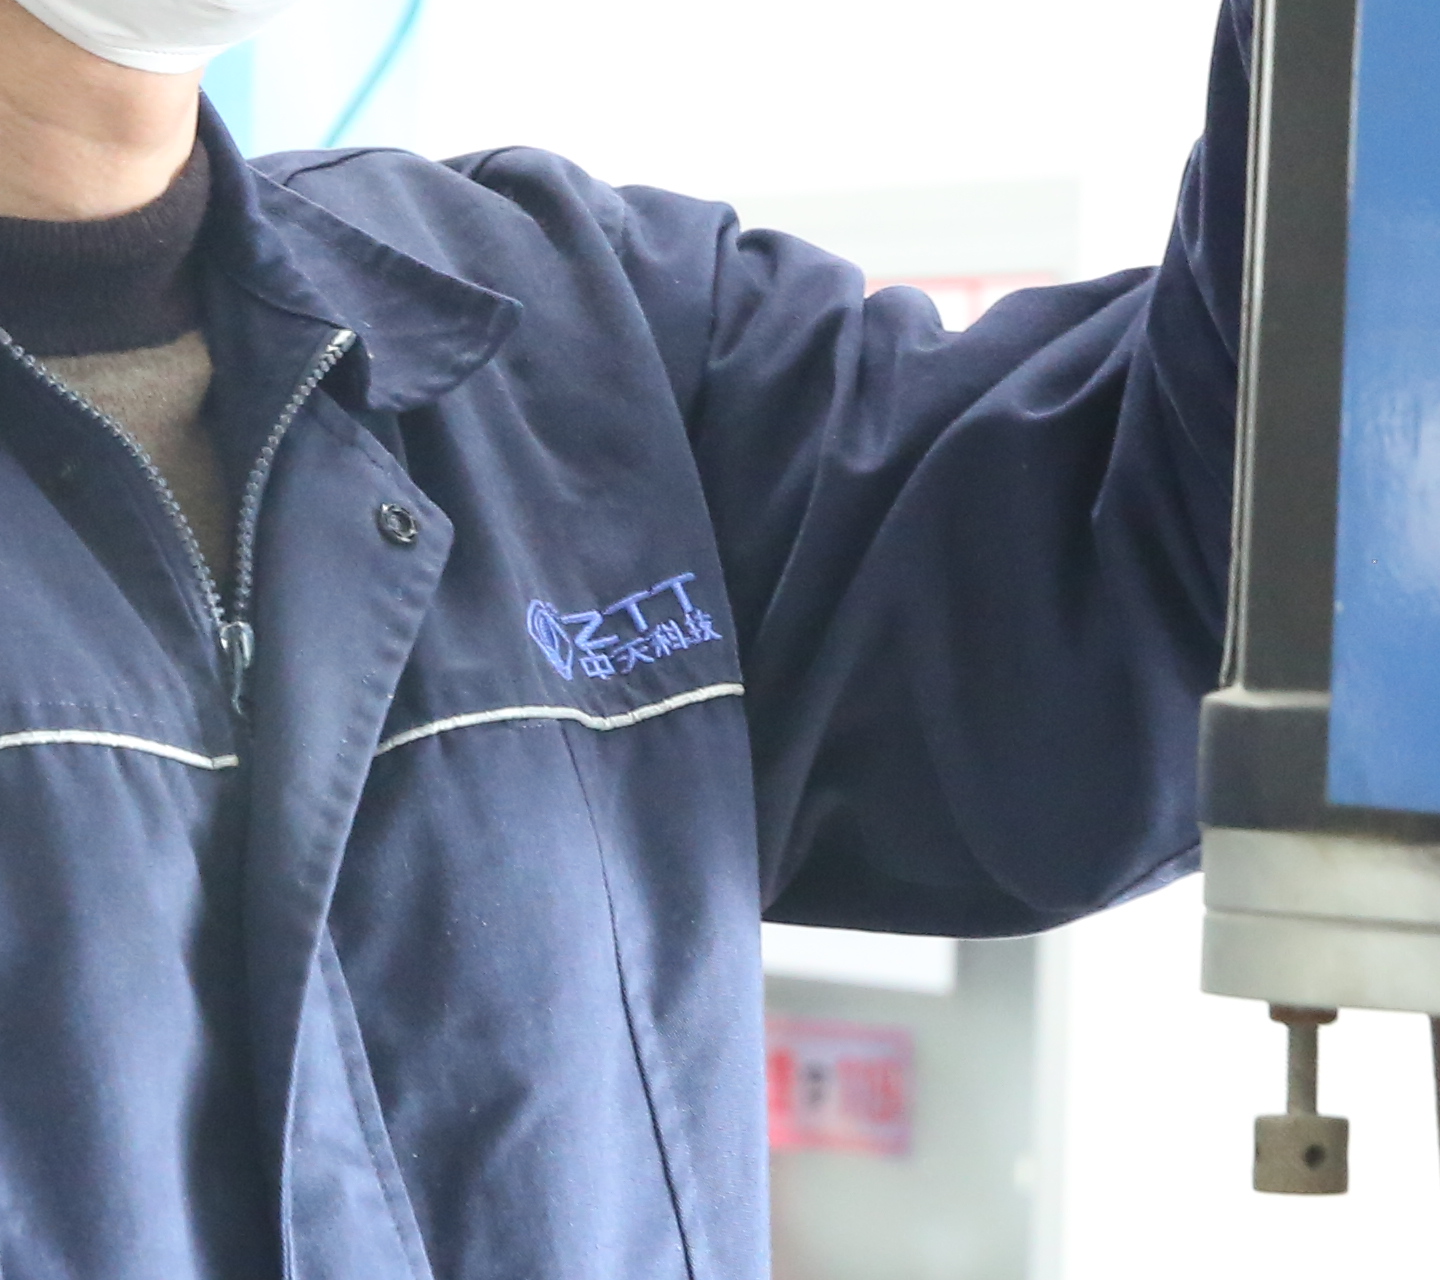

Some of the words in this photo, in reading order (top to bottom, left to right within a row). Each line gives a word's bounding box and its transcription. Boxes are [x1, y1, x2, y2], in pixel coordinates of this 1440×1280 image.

[561, 572, 696, 649] ZTT
[579, 609, 722, 680] 中天科技
